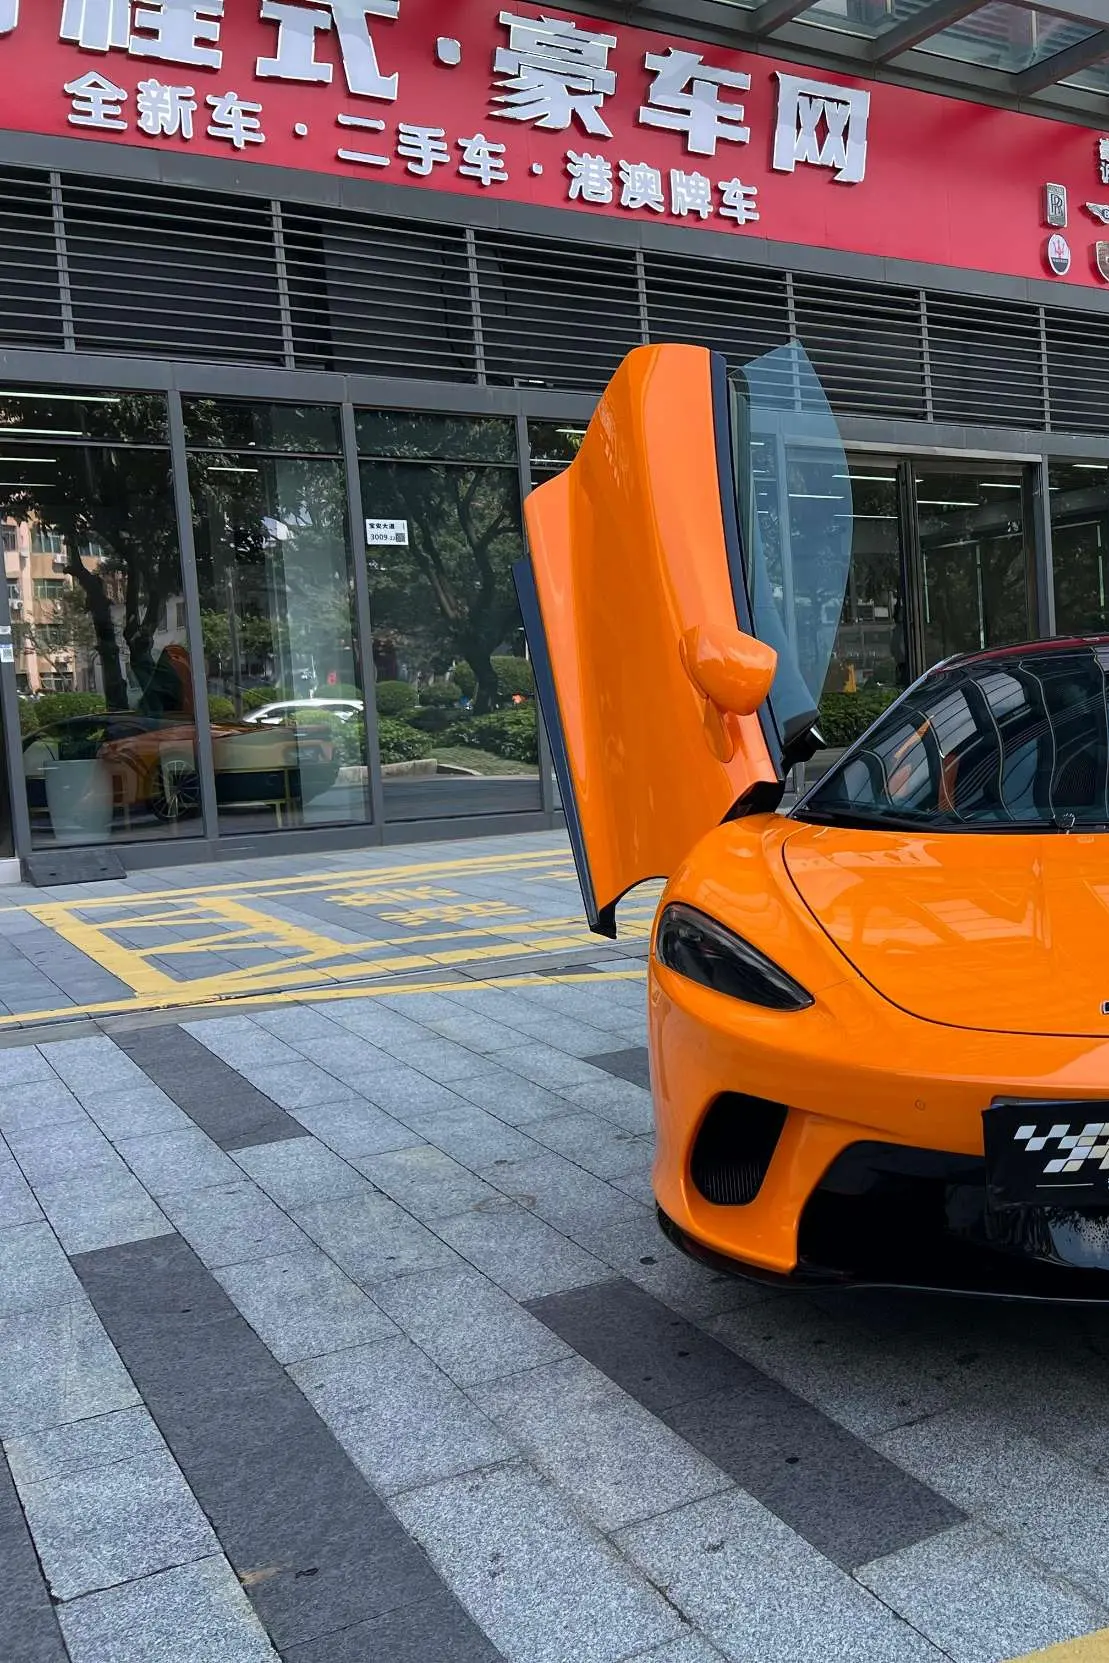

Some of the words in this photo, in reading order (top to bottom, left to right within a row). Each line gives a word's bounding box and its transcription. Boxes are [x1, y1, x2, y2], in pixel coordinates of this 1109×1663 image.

[0, 0, 870, 183] 程式·豪车网
[64, 70, 760, 226] 全新车·二手车·港澳牌车
